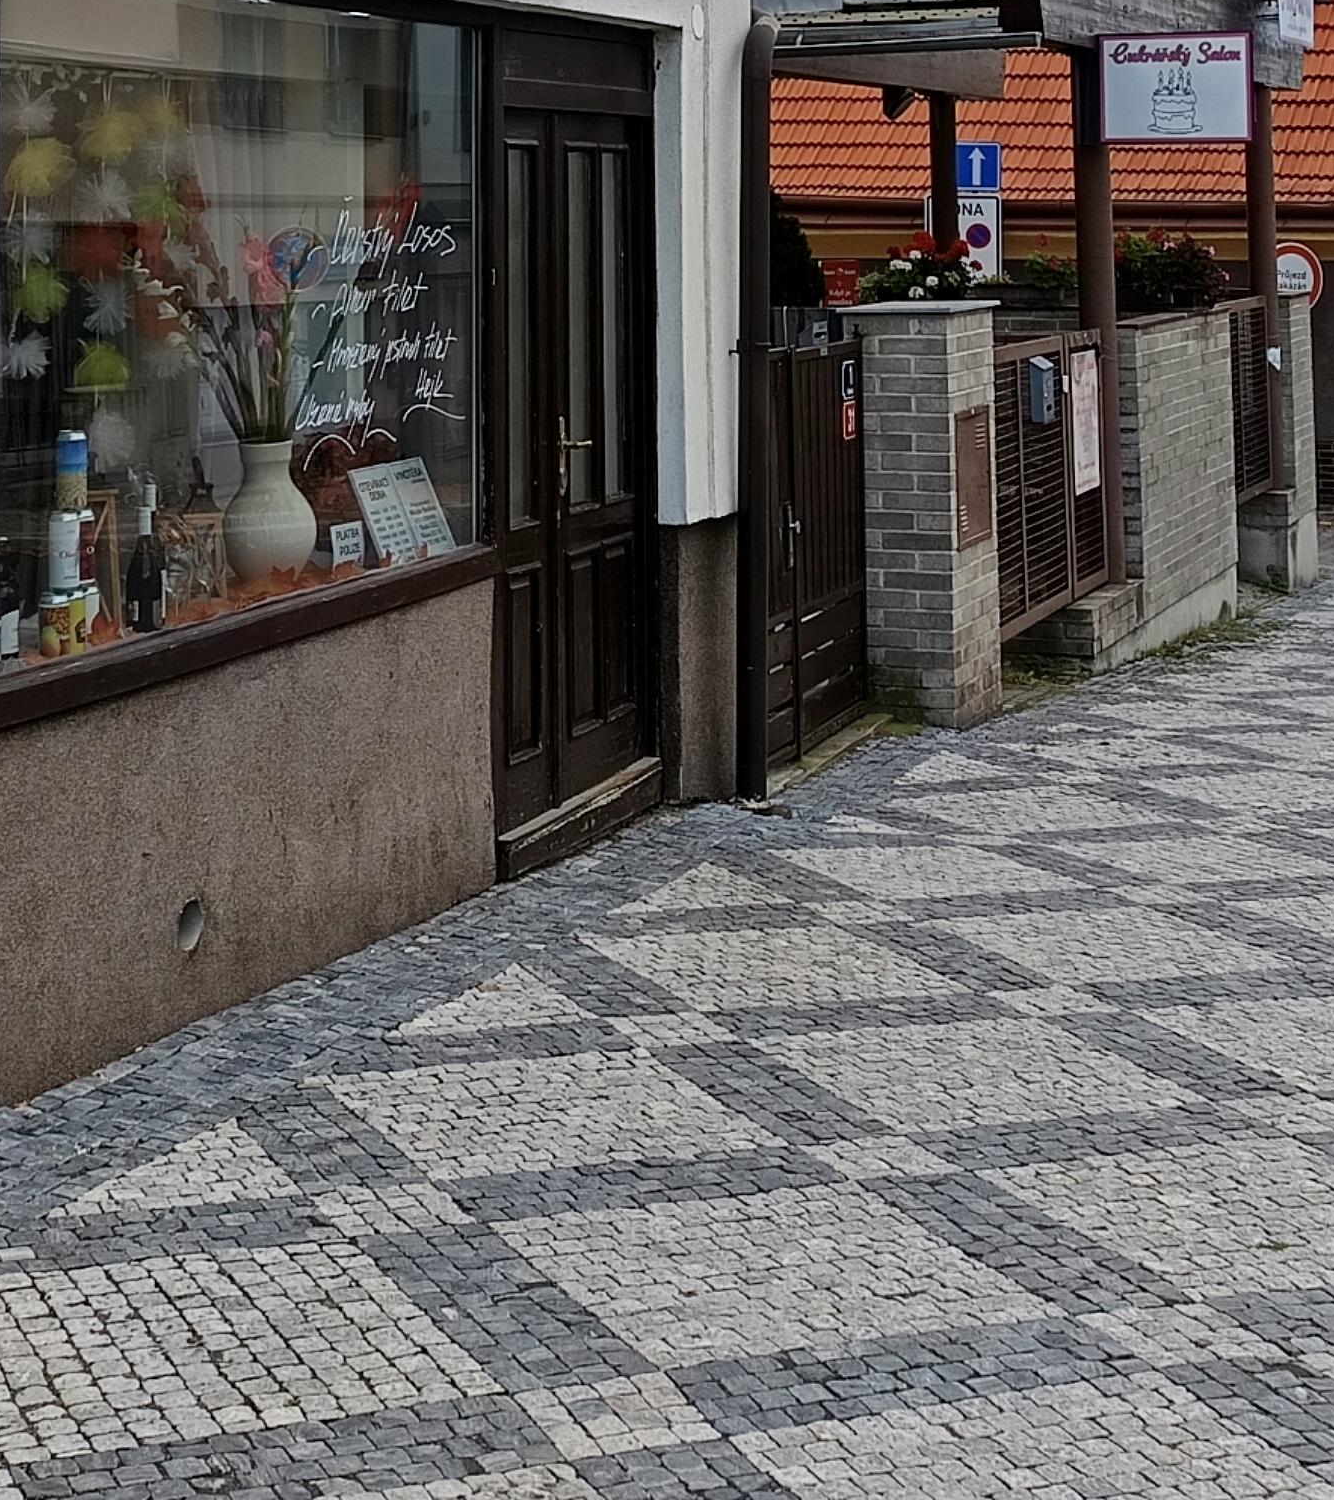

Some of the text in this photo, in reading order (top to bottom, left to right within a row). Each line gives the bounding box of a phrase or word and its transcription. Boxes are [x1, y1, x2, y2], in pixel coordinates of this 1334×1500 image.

[1109, 41, 1242, 67] Cukrářský Salon
[1278, 281, 1307, 291] akázán
